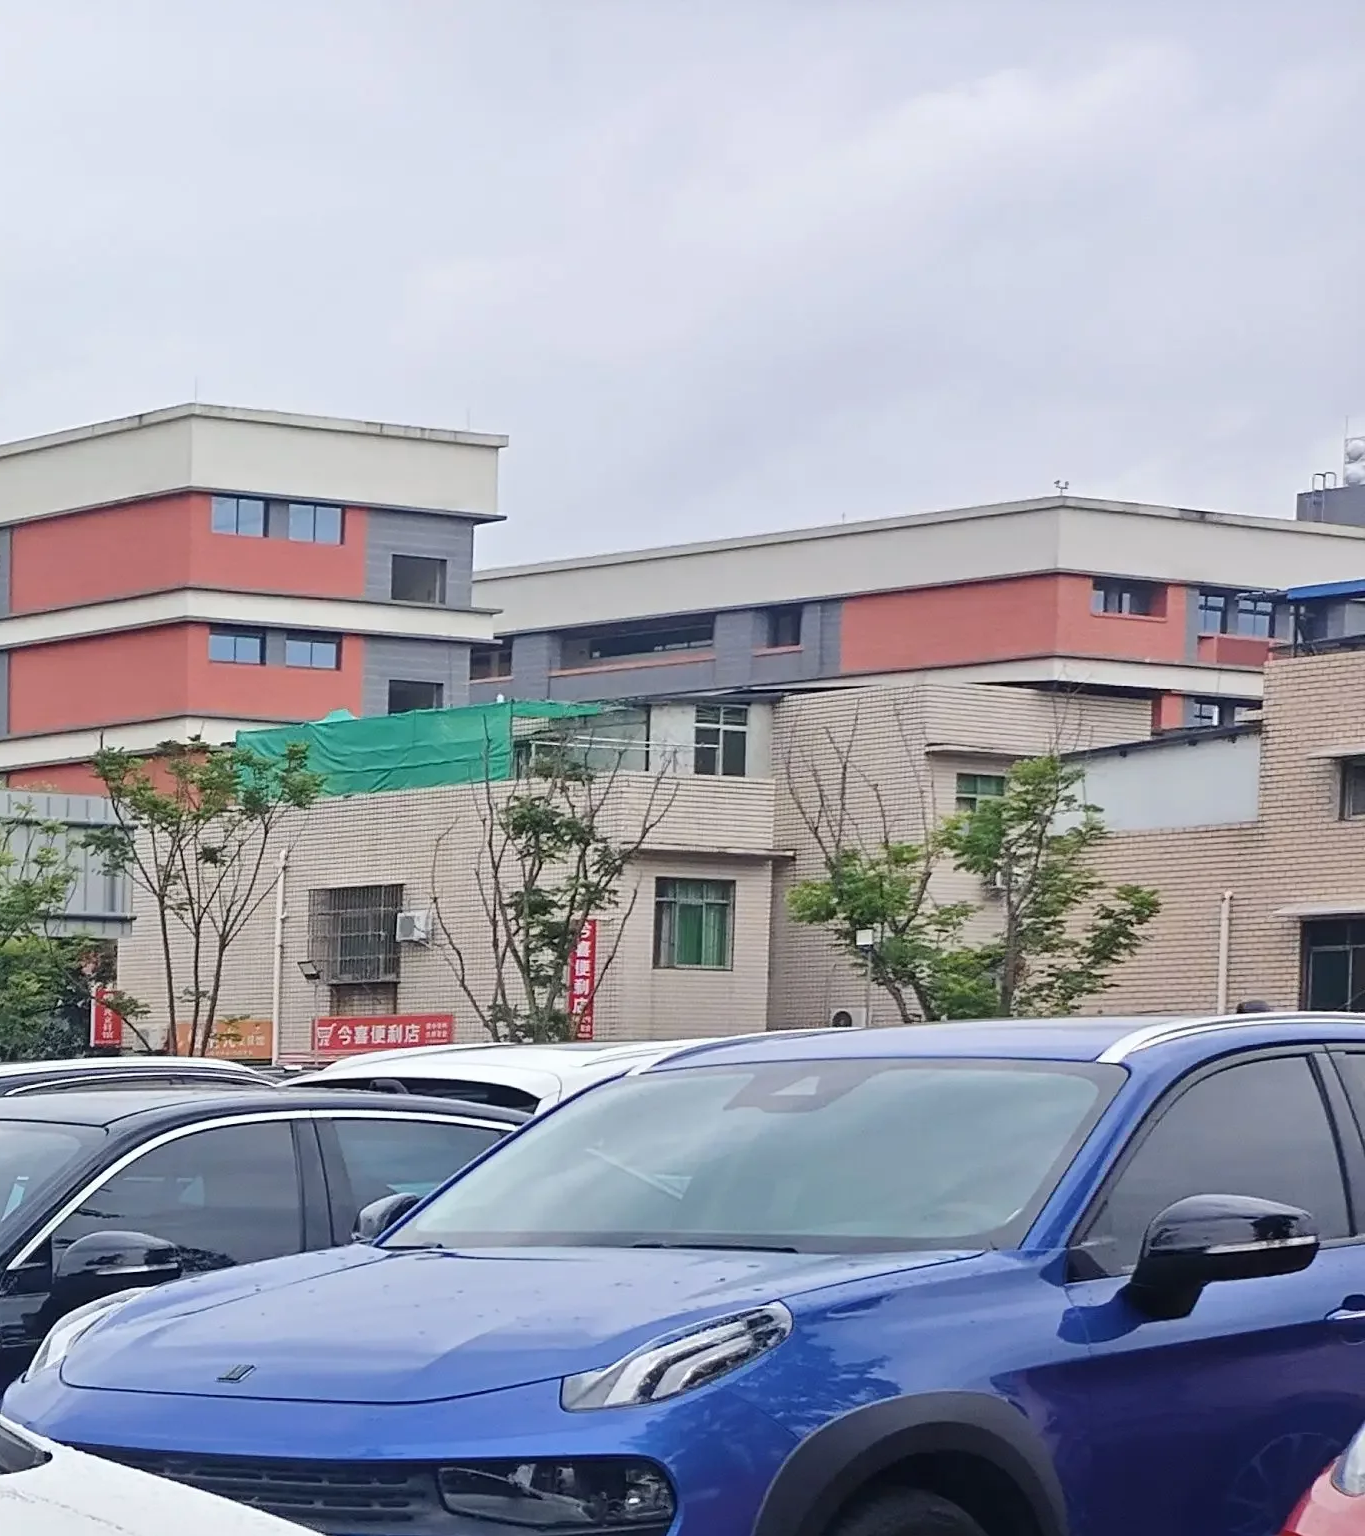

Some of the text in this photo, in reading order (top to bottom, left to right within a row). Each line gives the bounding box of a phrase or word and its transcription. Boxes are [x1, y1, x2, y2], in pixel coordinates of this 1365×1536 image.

[338, 1024, 420, 1045] 今喜便利店
